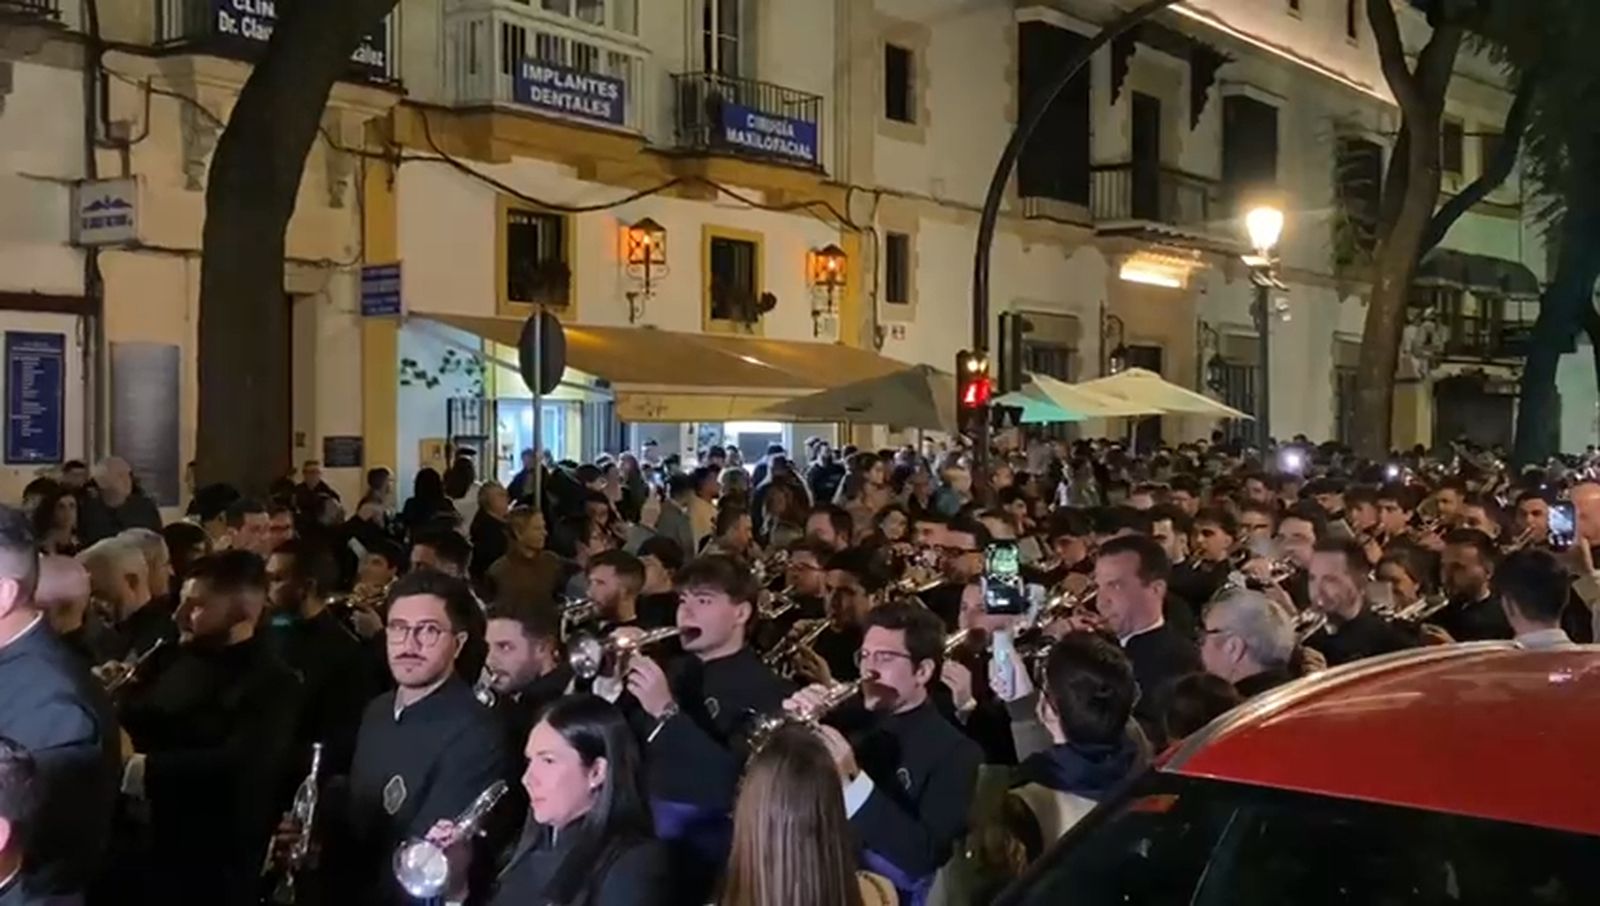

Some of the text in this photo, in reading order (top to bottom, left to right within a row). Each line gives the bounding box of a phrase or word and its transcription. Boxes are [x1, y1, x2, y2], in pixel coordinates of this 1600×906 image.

[218, 10, 239, 35] Dr.
[522, 62, 619, 100] IMPLANTES
[530, 85, 612, 118] DENTALES
[726, 127, 814, 160] MAXILOFACIAL
